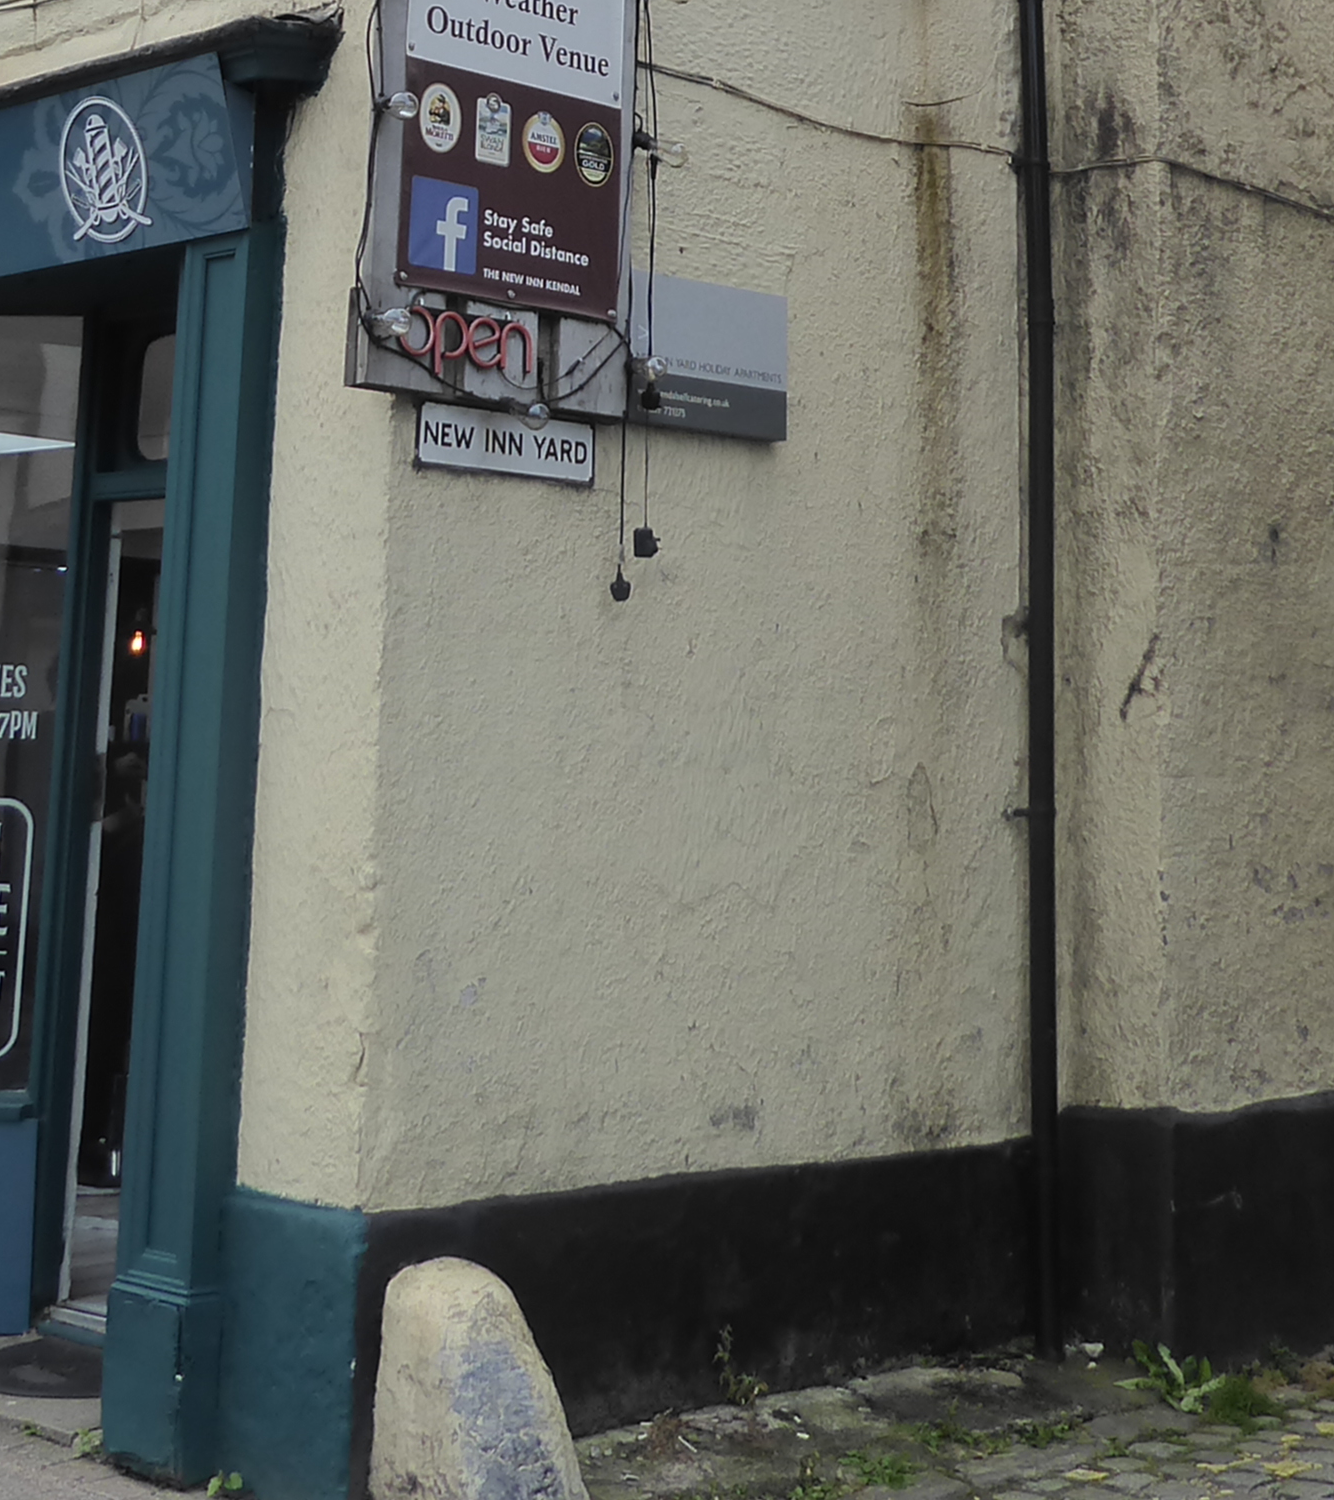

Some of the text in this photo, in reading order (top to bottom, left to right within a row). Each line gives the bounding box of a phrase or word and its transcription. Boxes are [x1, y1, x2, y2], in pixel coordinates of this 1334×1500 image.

[426, 5, 610, 78] Outdoor Venue
[530, 132, 557, 145] AMSTEL
[582, 159, 605, 171] GOLD
[436, 196, 469, 272] f
[484, 208, 553, 238] Stay Safe
[483, 231, 589, 266] Social Distance
[482, 267, 581, 296] THE NEW INN KENDAL
[675, 357, 697, 371] YARD
[698, 361, 732, 376] HOLIDAY
[733, 367, 782, 385] APARTMENTS
[423, 420, 588, 464] NEW INN YARD
